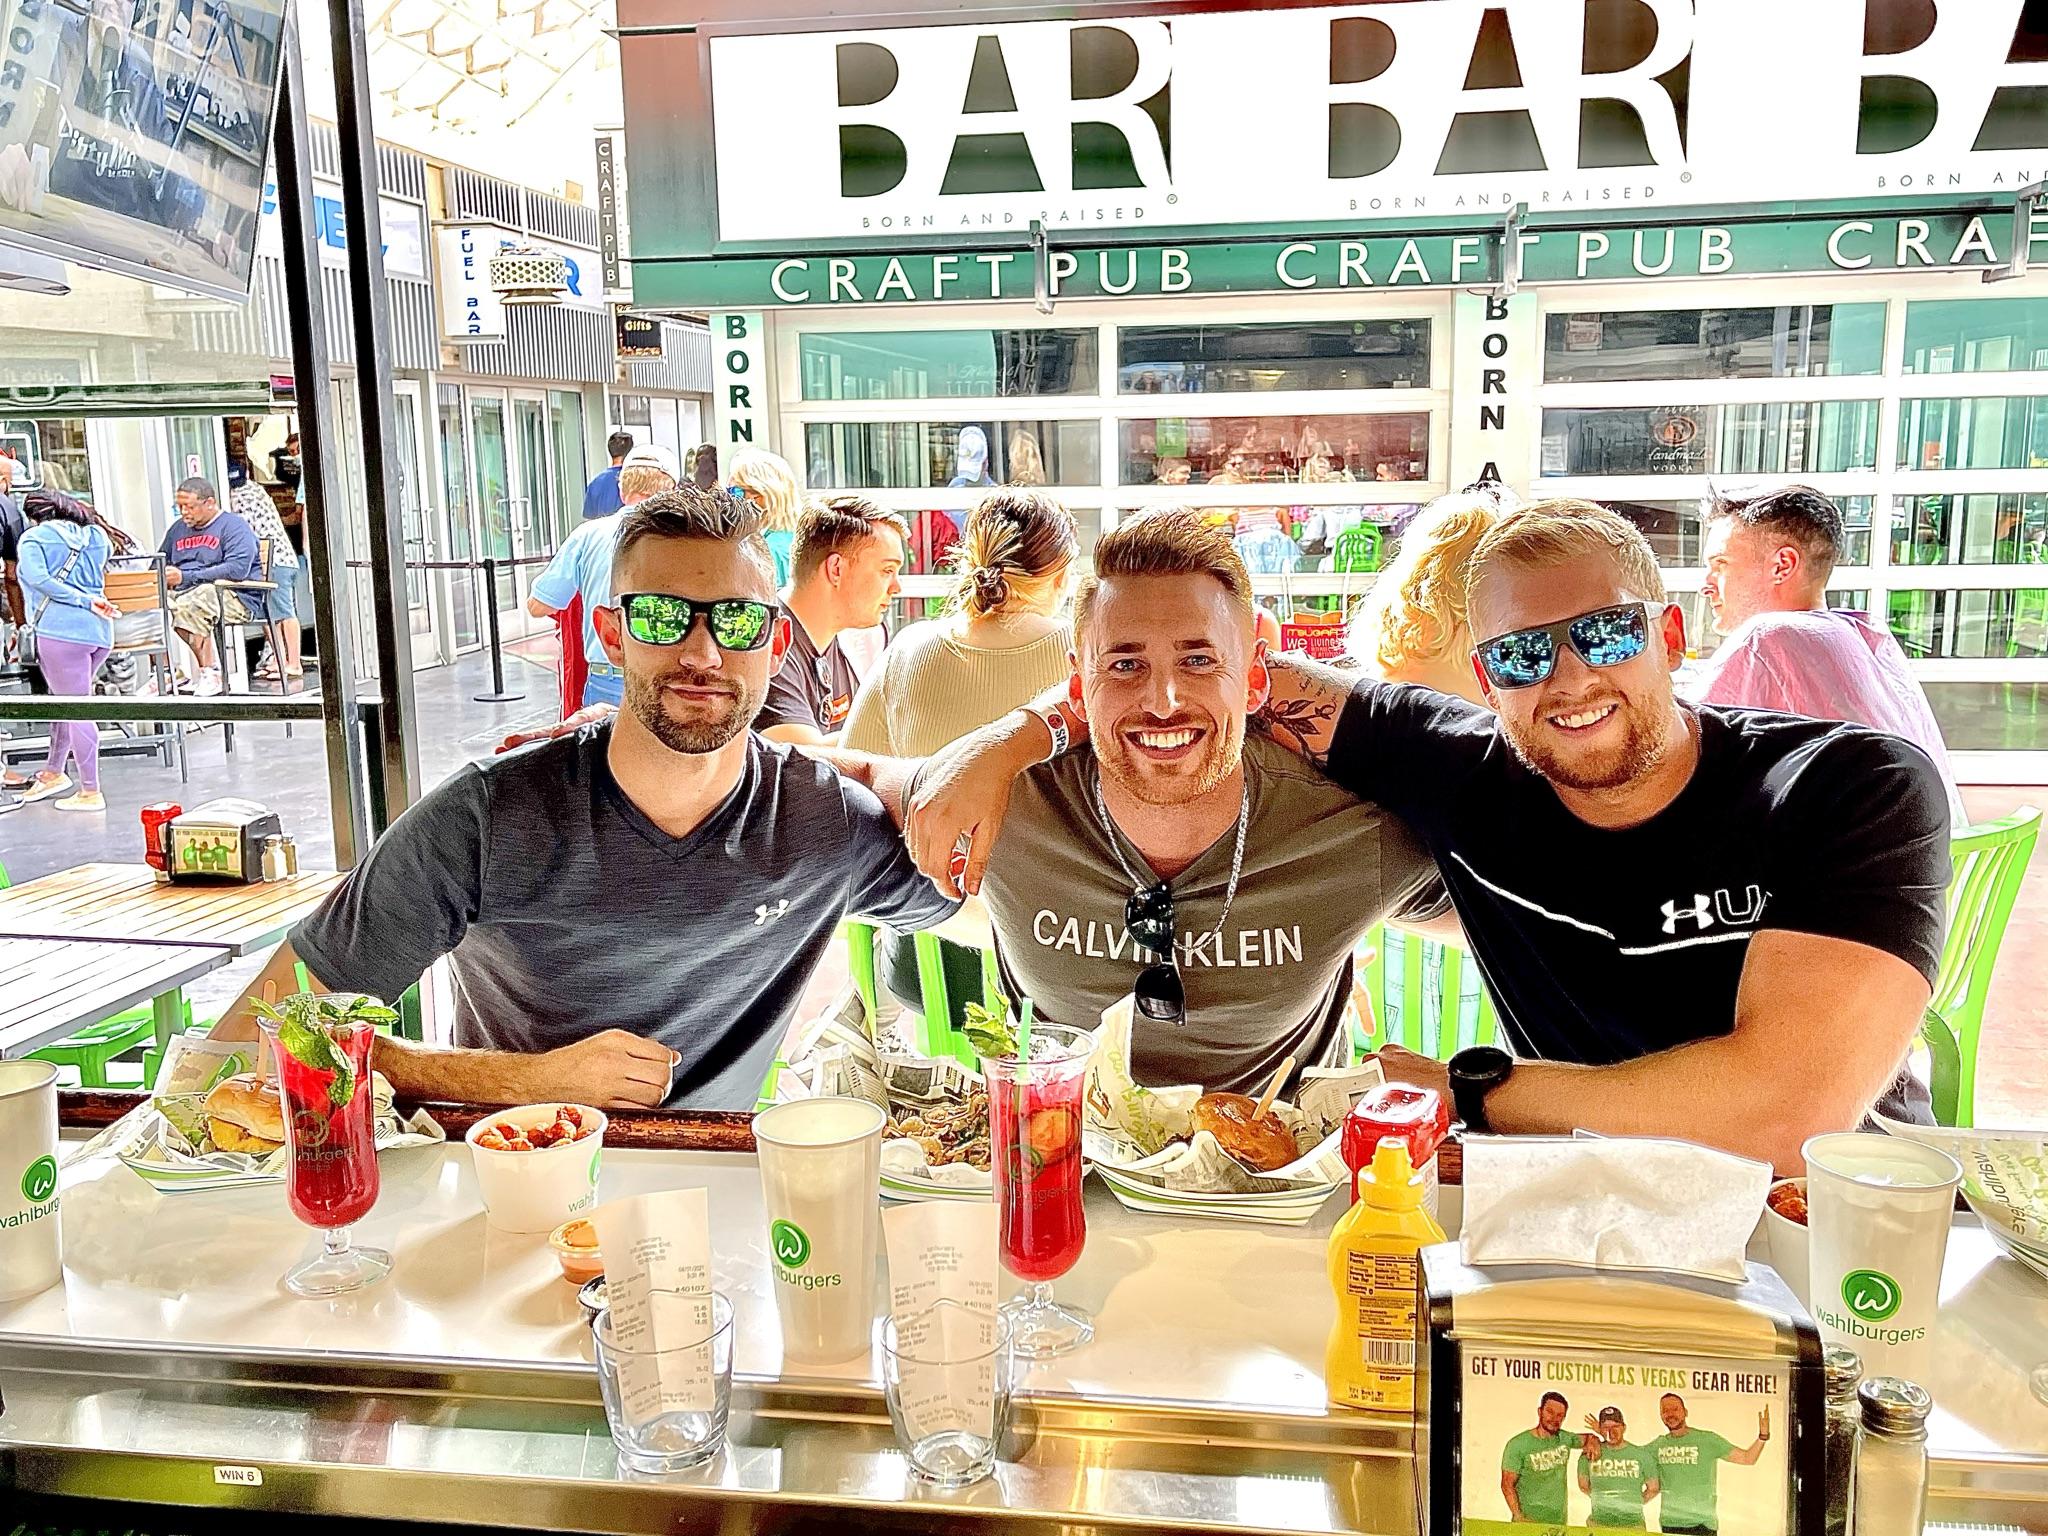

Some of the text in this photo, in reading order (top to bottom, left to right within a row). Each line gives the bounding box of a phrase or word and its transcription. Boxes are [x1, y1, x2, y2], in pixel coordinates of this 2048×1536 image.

[836, 22, 1173, 198] BAR
[1328, 0, 1695, 179] BAR
[1350, 186, 1656, 211] BORN AND RAISED
[1878, 170, 2048, 188] BORN AN
[598, 142, 617, 283] CRAFT PUB
[862, 206, 1145, 228] BORN AND RAISED
[461, 229, 481, 334] FUEL BAR
[771, 248, 1193, 303] CRAFT PUB
[1275, 228, 1735, 288] CRAFT PUB
[725, 315, 753, 443] BORN
[1480, 295, 1508, 431] BORN
[1032, 909, 1304, 968] CALVI KLEIN
[1816, 1303, 1925, 1345] wahlburgers
[1472, 1356, 1778, 1394] GET YOUR CUSTOM LAS VEGAS GEAR HERE!
[219, 1468, 255, 1482] WIN 6
